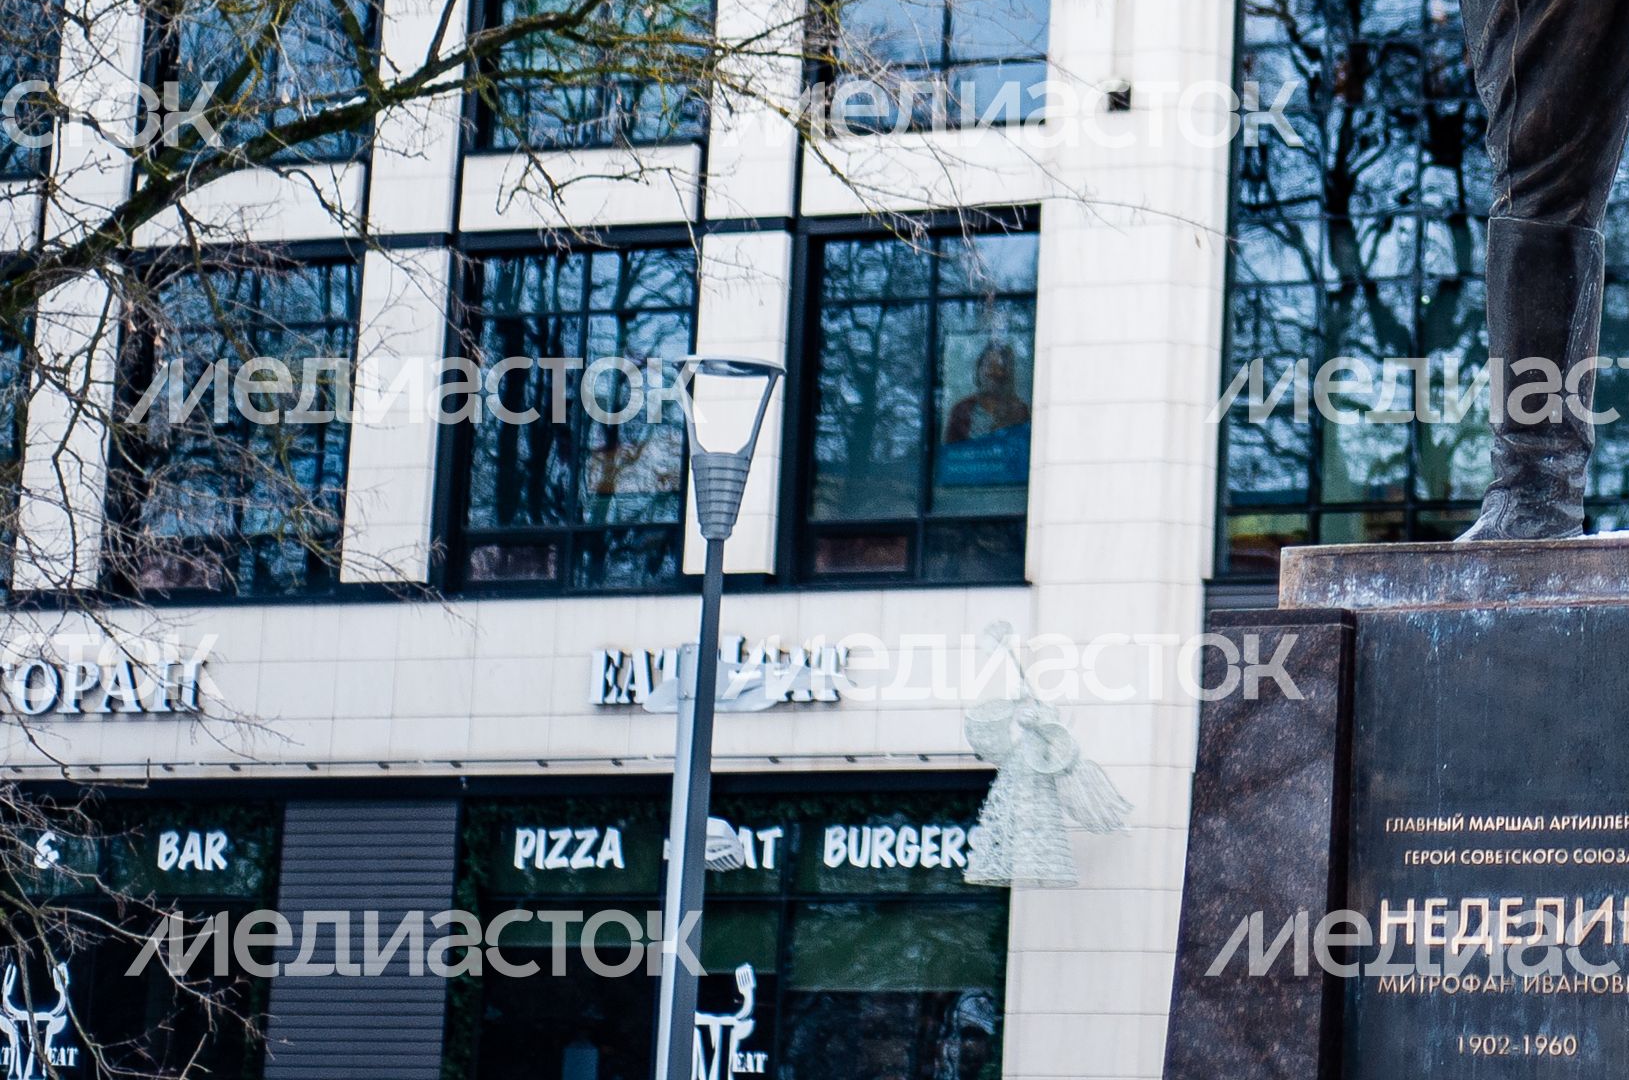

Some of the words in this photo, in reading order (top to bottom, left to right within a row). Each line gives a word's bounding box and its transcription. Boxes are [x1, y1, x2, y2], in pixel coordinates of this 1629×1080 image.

[1385, 812, 1464, 833] ГЛАВНЫЙ
[1468, 815, 1544, 832] МАРШАЛ
[157, 831, 228, 871] BAR
[513, 826, 625, 869] PIZZA
[1460, 848, 1568, 865] СОВЕТСКОГО
[1377, 972, 1516, 994] МИТРОФАН
[1457, 1034, 1578, 1056] 1902-1960
